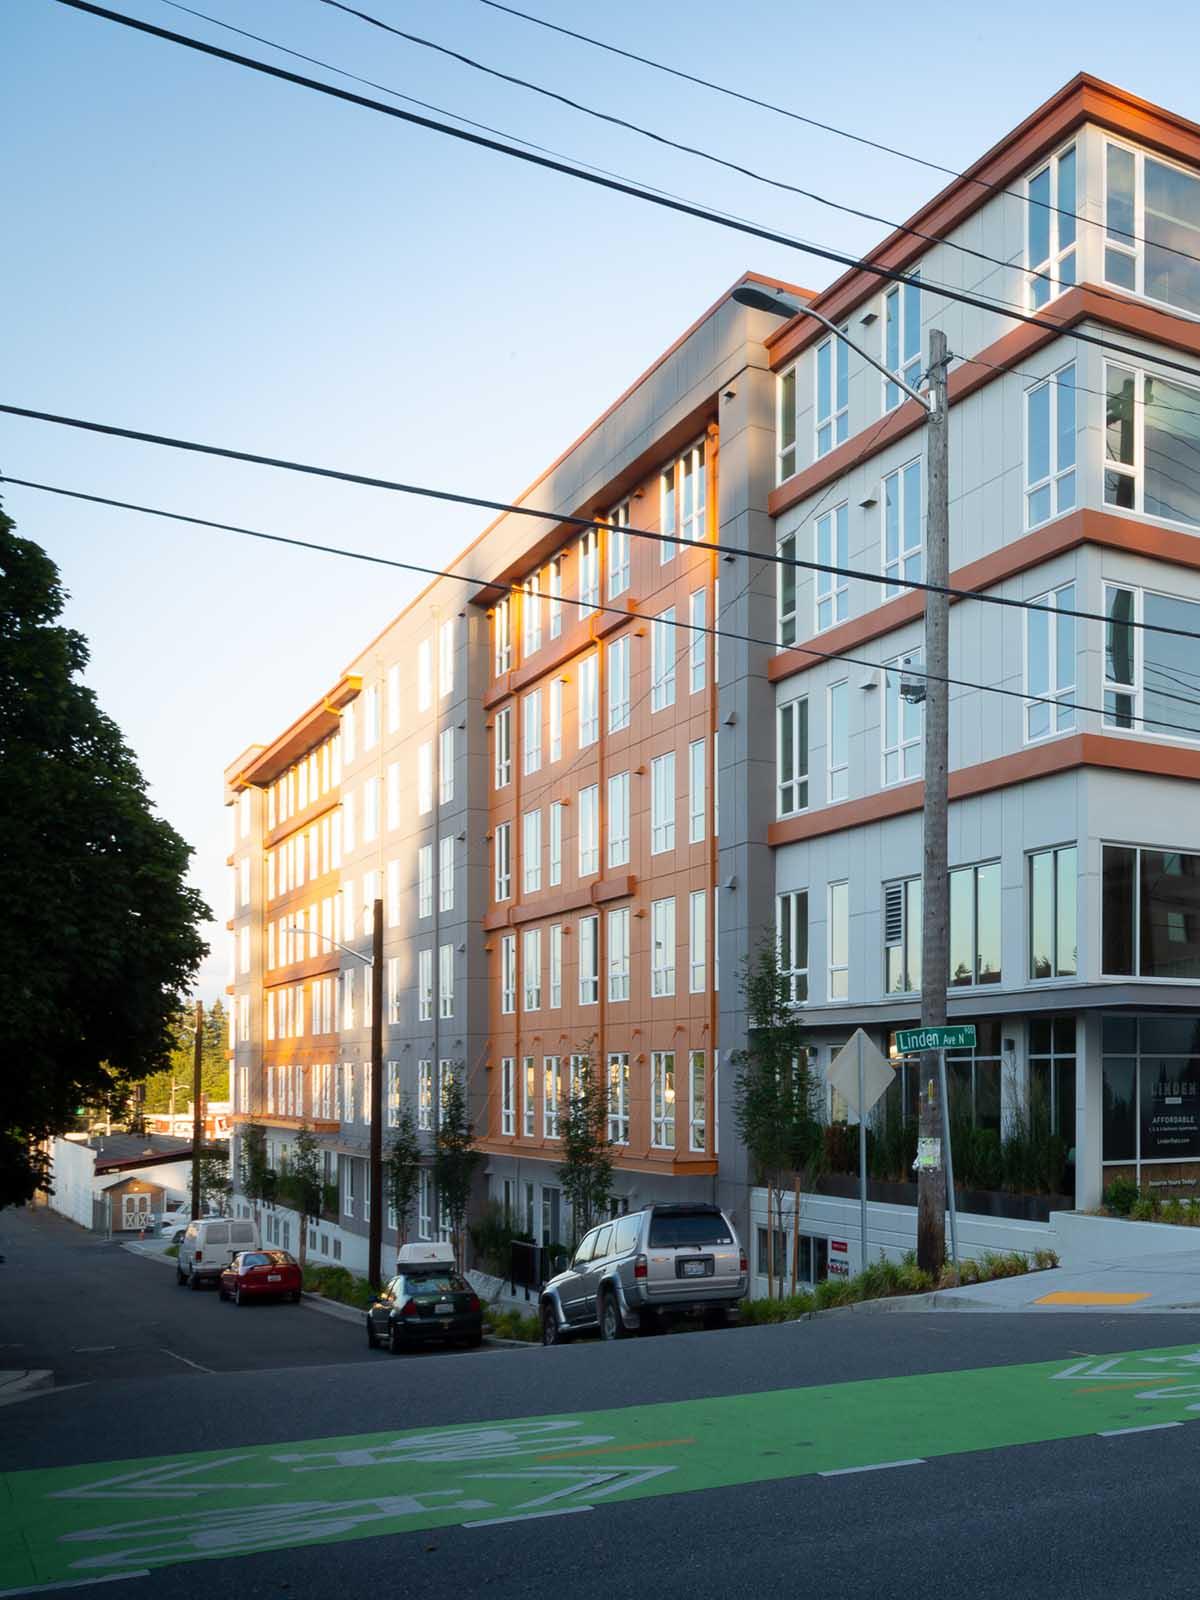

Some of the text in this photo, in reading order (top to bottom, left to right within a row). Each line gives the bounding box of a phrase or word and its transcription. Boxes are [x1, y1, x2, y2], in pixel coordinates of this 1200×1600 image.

[900, 1032, 965, 1050] Linden Ave N
[1151, 1081, 1197, 1097] LINDEN
[1151, 1115, 1195, 1124] AFFORDABLE
